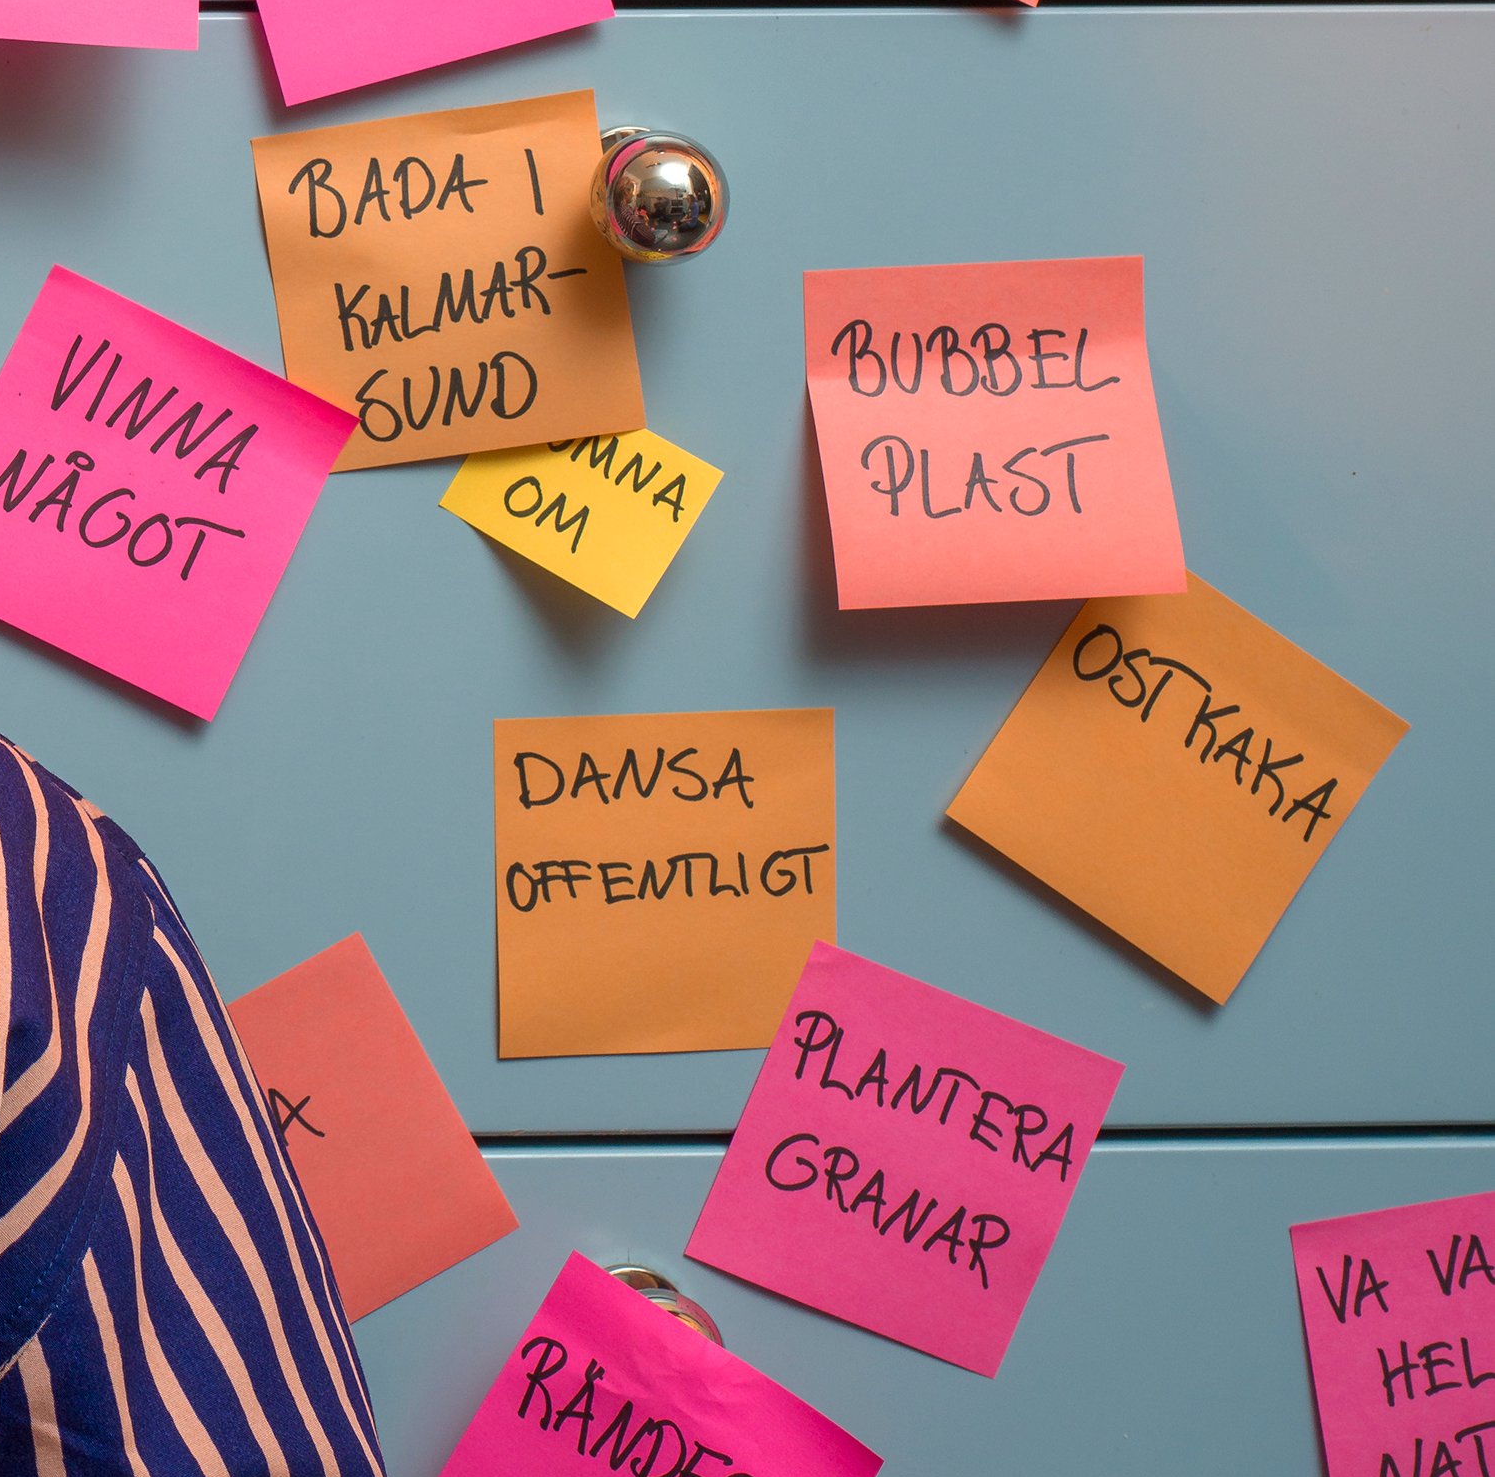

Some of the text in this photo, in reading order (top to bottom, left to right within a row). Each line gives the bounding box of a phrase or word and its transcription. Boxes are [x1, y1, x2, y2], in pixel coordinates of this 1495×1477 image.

[288, 148, 544, 239] BADA I
[334, 245, 588, 352] KALMAR-
[355, 350, 538, 443] SUND
[832, 319, 1119, 399] BUBBEL
[49, 333, 260, 495] VINNA
[503, 476, 589, 554] OM
[861, 433, 1109, 519] PLAST
[513, 747, 755, 810] DANSA
[505, 844, 830, 913] OFFENTLIGT
[793, 1008, 1074, 1183] PLANTERA
[765, 1132, 1011, 1291] GRANAR
[1315, 1253, 1389, 1325] VA
